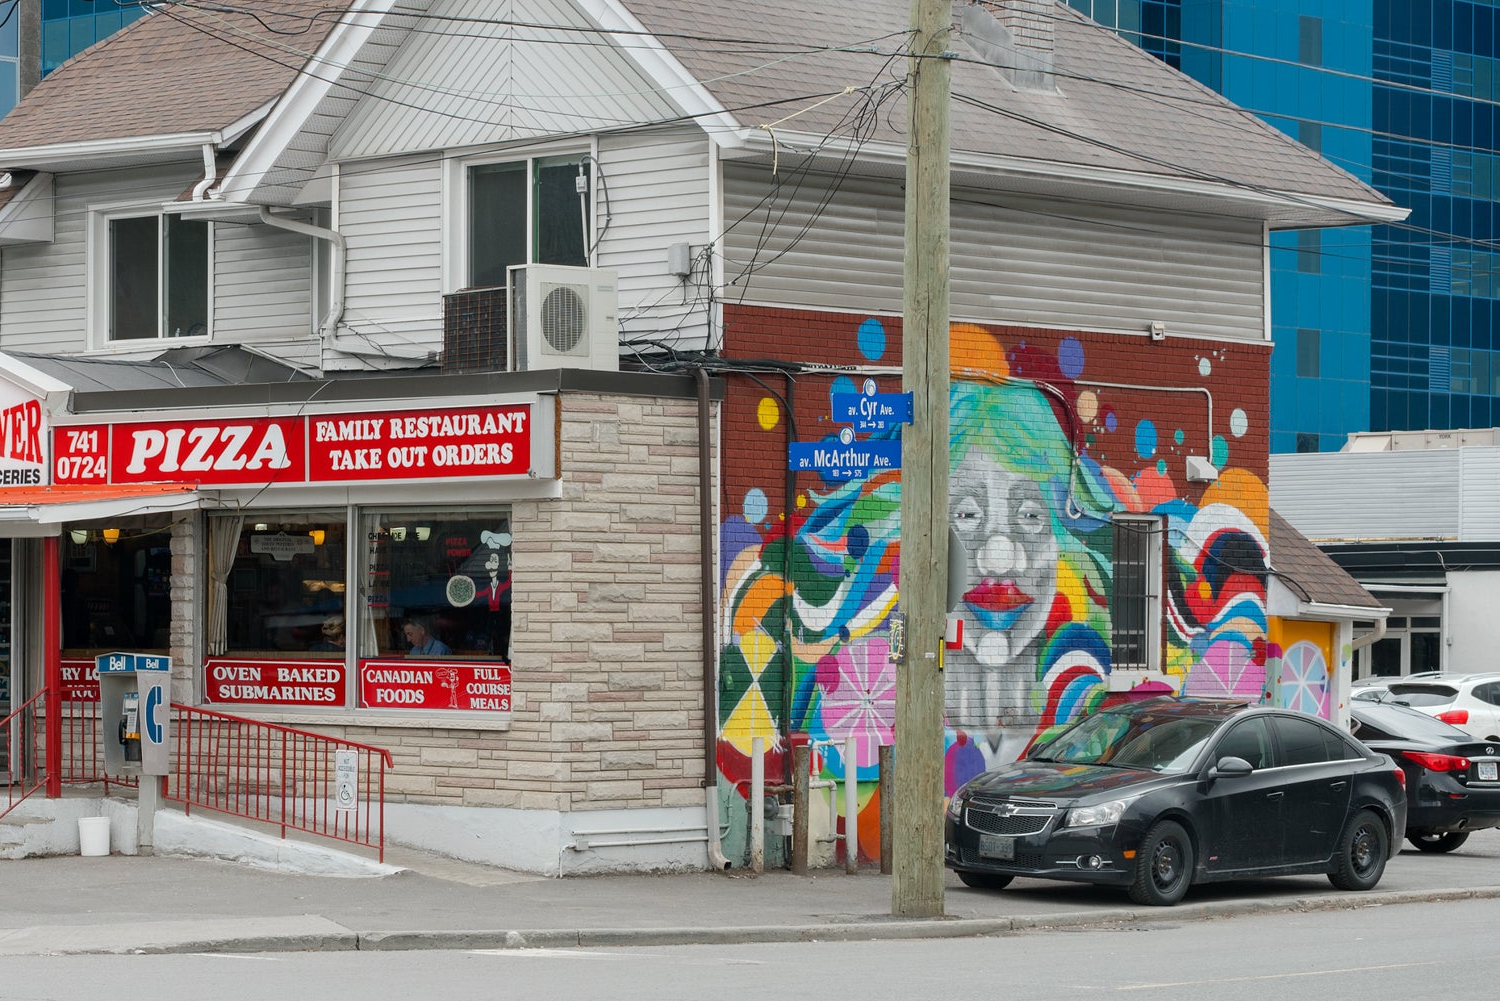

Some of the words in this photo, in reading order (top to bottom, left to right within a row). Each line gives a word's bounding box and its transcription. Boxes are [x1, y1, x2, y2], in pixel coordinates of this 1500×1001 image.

[848, 405, 858, 416] av.
[860, 398, 877, 420] Cyr
[880, 404, 894, 416] Ave.
[316, 419, 384, 442] FAMILY
[390, 412, 526, 439] RESTAURANT
[67, 430, 98, 453] 741
[126, 424, 292, 474] PIZZA
[329, 448, 382, 470] TAKE
[387, 446, 428, 468] OUT
[432, 443, 513, 466] ORDERS
[799, 457, 812, 467] av.
[814, 448, 870, 467] McArthur
[874, 455, 892, 466] Ave.
[57, 455, 106, 478] 0724
[110, 656, 126, 670] Bell
[146, 658, 159, 669] Bell
[213, 666, 262, 682] OVEN
[278, 668, 340, 683] BAKED
[366, 670, 433, 684] CANADIAN
[474, 668, 501, 680] FULL
[219, 685, 336, 702] SUBMARINES
[376, 688, 425, 704] FOODS
[466, 682, 511, 696] COURSE
[470, 698, 509, 711] MEALS
